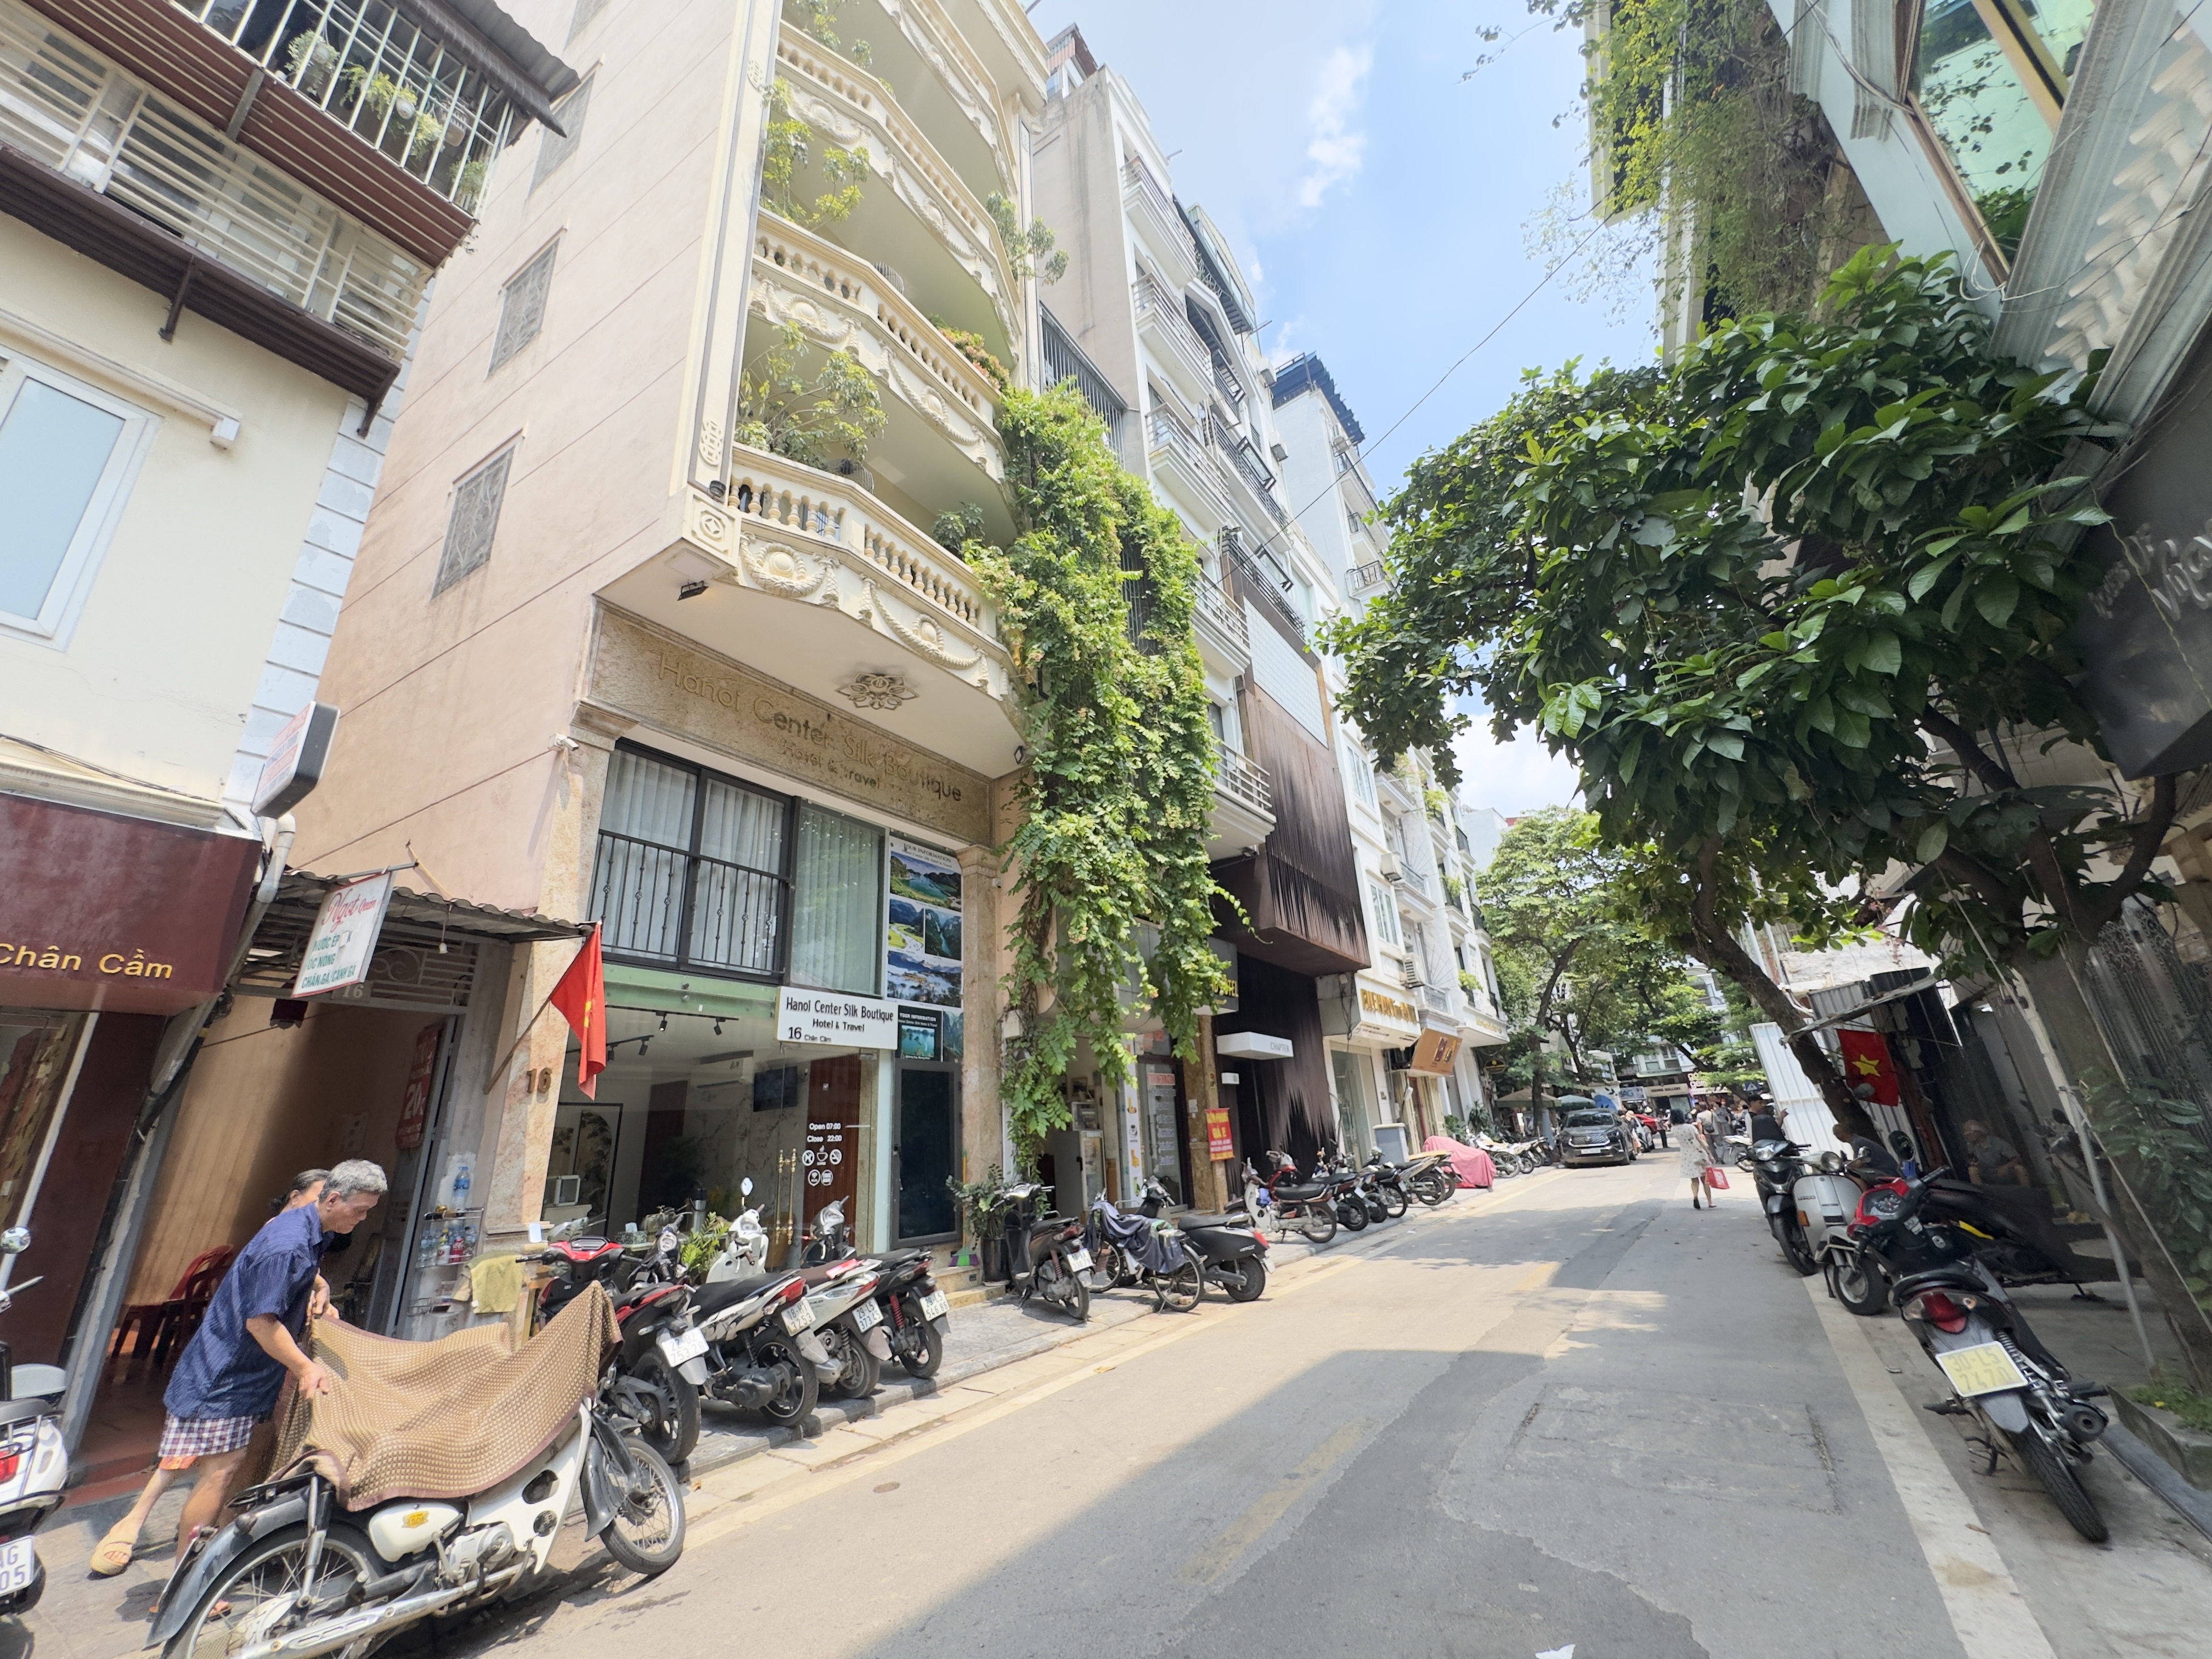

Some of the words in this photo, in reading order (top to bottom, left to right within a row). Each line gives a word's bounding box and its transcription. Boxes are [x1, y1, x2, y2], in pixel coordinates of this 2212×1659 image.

[659, 653, 741, 713] Hanoi
[754, 697, 834, 749] Center
[844, 735, 877, 768] Silk
[918, 848, 952, 863] INFORMATION
[98, 948, 173, 979] Cầm
[342, 984, 364, 998] 16
[786, 997, 811, 1012] Hanoi
[815, 1000, 842, 1015] Center
[844, 1003, 859, 1017] Silk
[861, 1006, 894, 1024] Boutique
[788, 1026, 802, 1040] 16
[812, 1018, 833, 1029] Hotel
[843, 1022, 865, 1032] Travel
[1270, 1041, 1289, 1053] CHAPTER
[527, 1066, 552, 1094] 16
[809, 1122, 826, 1131] Open
[856, 1301, 875, 1319] 29-L5
[791, 1313, 813, 1332] 3253
